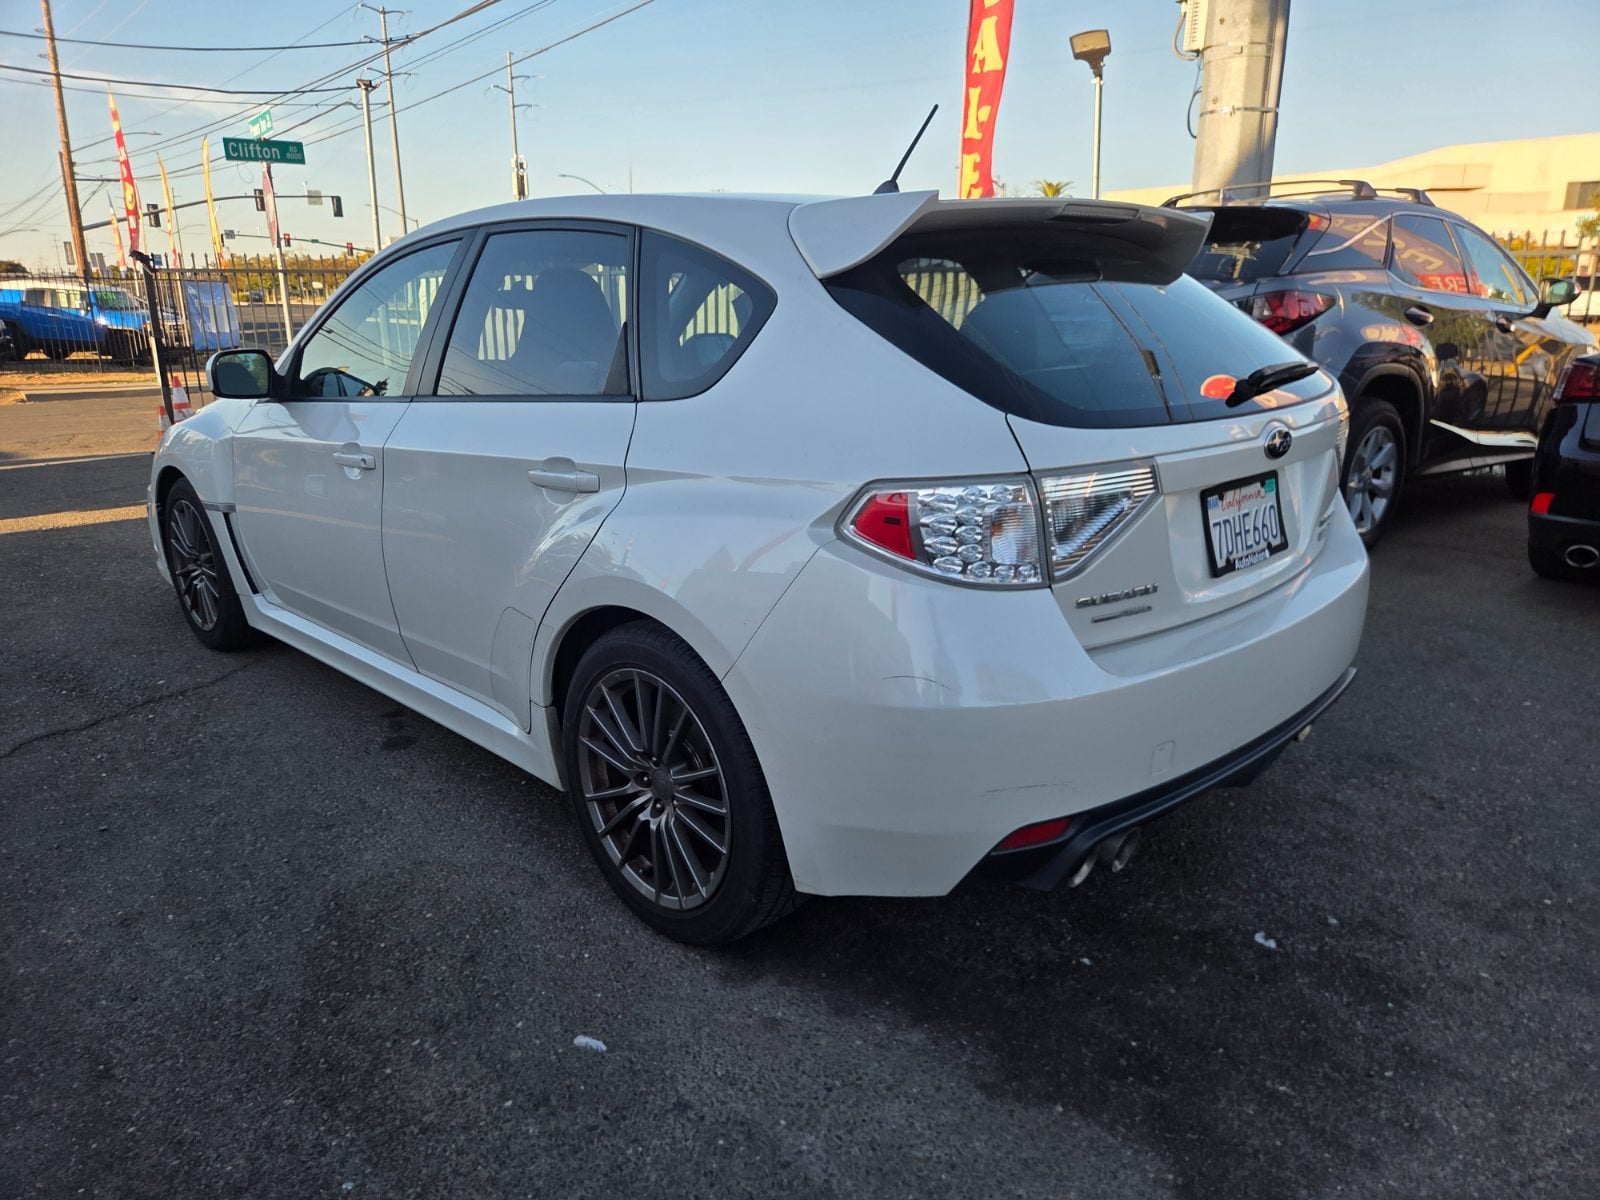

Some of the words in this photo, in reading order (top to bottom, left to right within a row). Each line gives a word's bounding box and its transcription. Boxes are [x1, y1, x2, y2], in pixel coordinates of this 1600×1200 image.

[960, 0, 1003, 199] ALE
[228, 141, 281, 159] Clifton
[1220, 487, 1265, 512] California
[1212, 504, 1278, 561] 7DHE660
